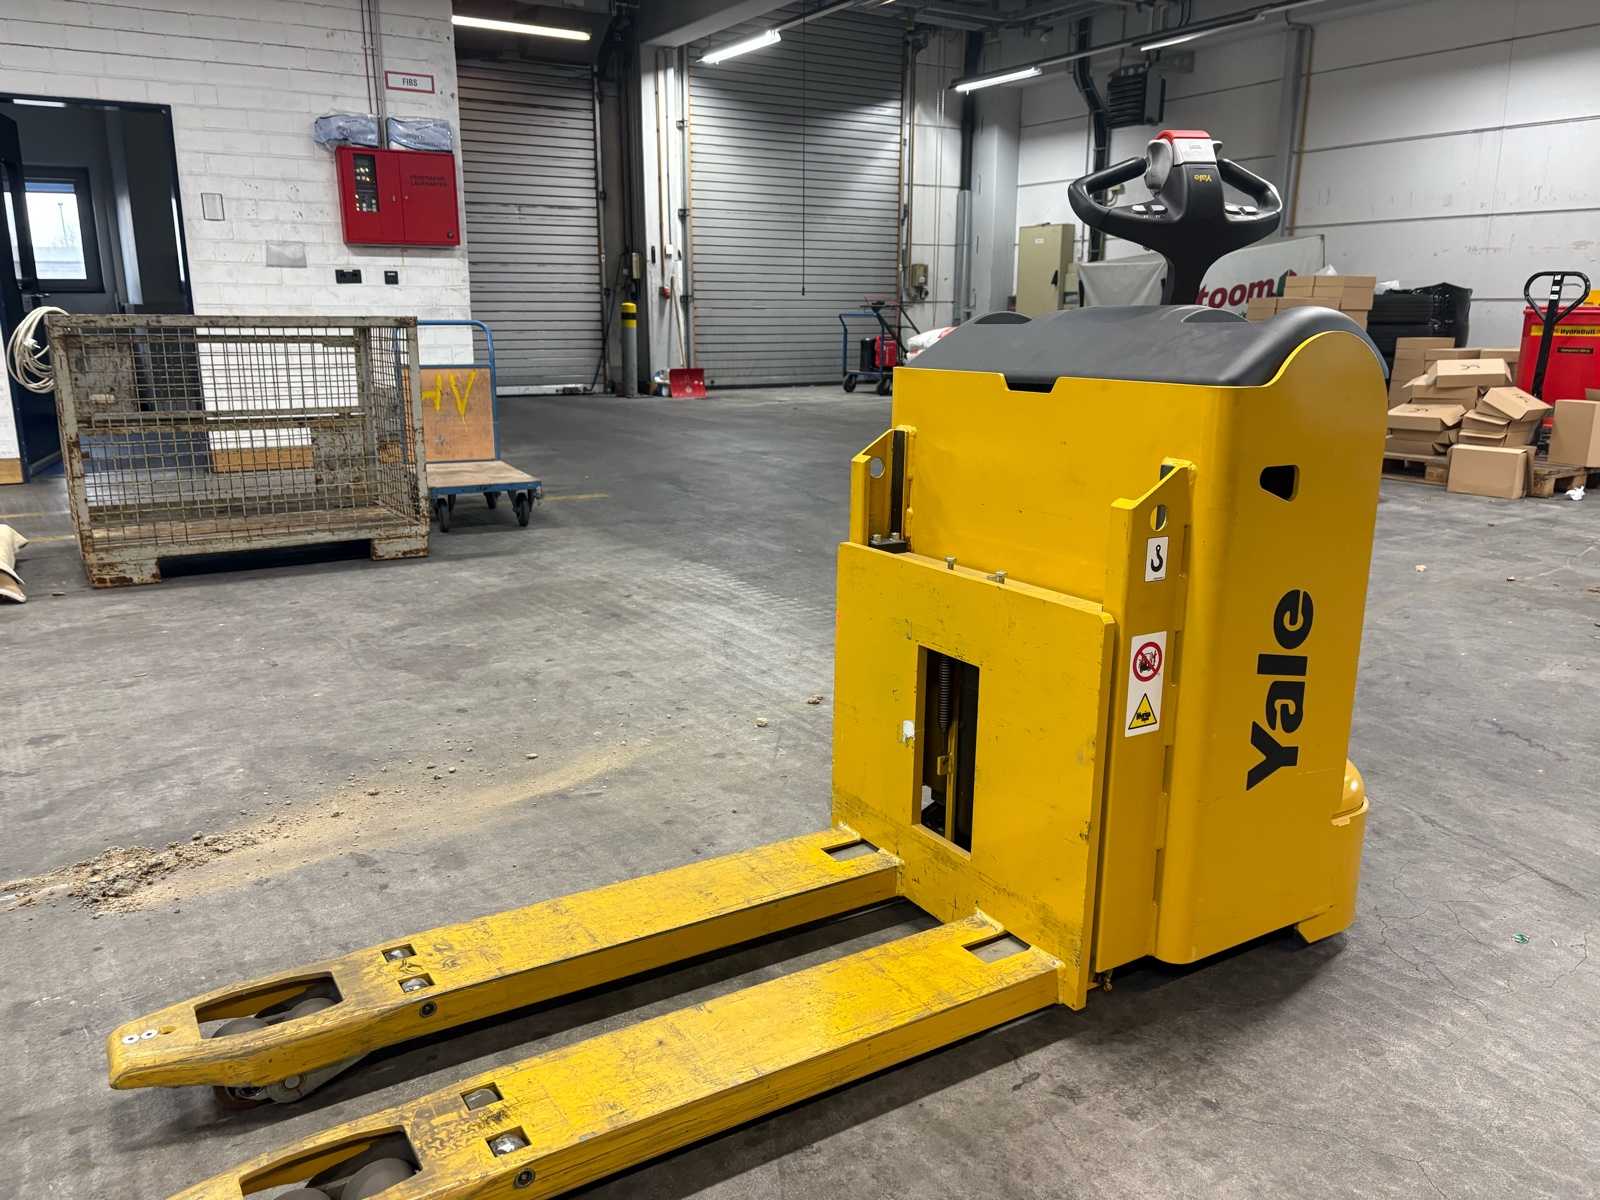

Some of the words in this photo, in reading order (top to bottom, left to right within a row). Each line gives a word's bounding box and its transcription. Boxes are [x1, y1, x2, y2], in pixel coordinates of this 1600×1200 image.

[1193, 174, 1213, 183] Yale
[1195, 278, 1276, 309] toom
[1246, 588, 1315, 791] Yale
